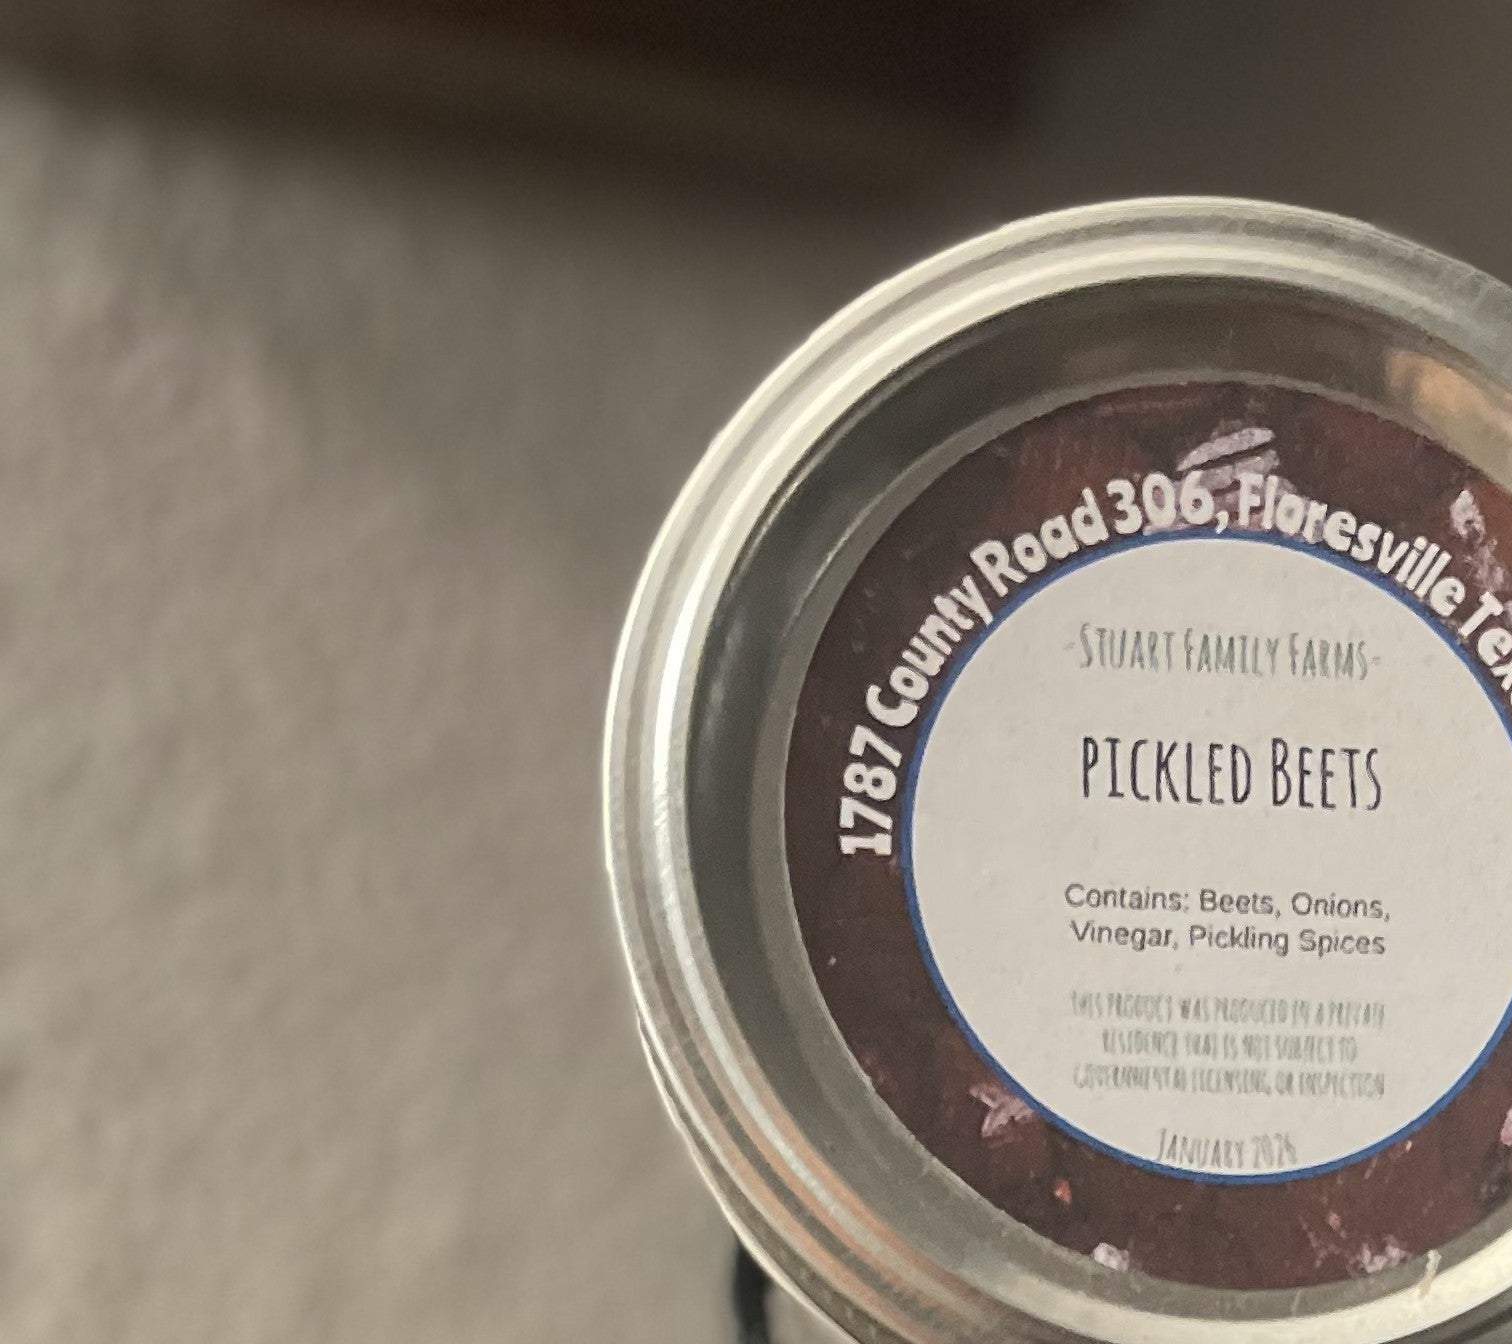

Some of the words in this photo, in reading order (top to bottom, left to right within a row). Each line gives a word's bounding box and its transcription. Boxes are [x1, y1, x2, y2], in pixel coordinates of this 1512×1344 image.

[1106, 470, 1229, 534] 306,
[969, 486, 1110, 598] Road
[1236, 471, 1467, 617] Floresville
[865, 574, 994, 728] County
[1183, 627, 1280, 678] FAMILY
[839, 724, 902, 856] 1787
[1082, 736, 1252, 805] PICKLED
[1271, 737, 1382, 811] BEETS
[1064, 883, 1190, 913] Contains:
[1199, 887, 1282, 920] Beets,
[1291, 891, 1391, 923] Onions,
[1070, 919, 1179, 952] Vinegar,
[1189, 924, 1289, 957] Pickling
[1299, 928, 1386, 958] Spices
[1180, 997, 1209, 1023] WAS
[1156, 1128, 1244, 1169] JANUARY
